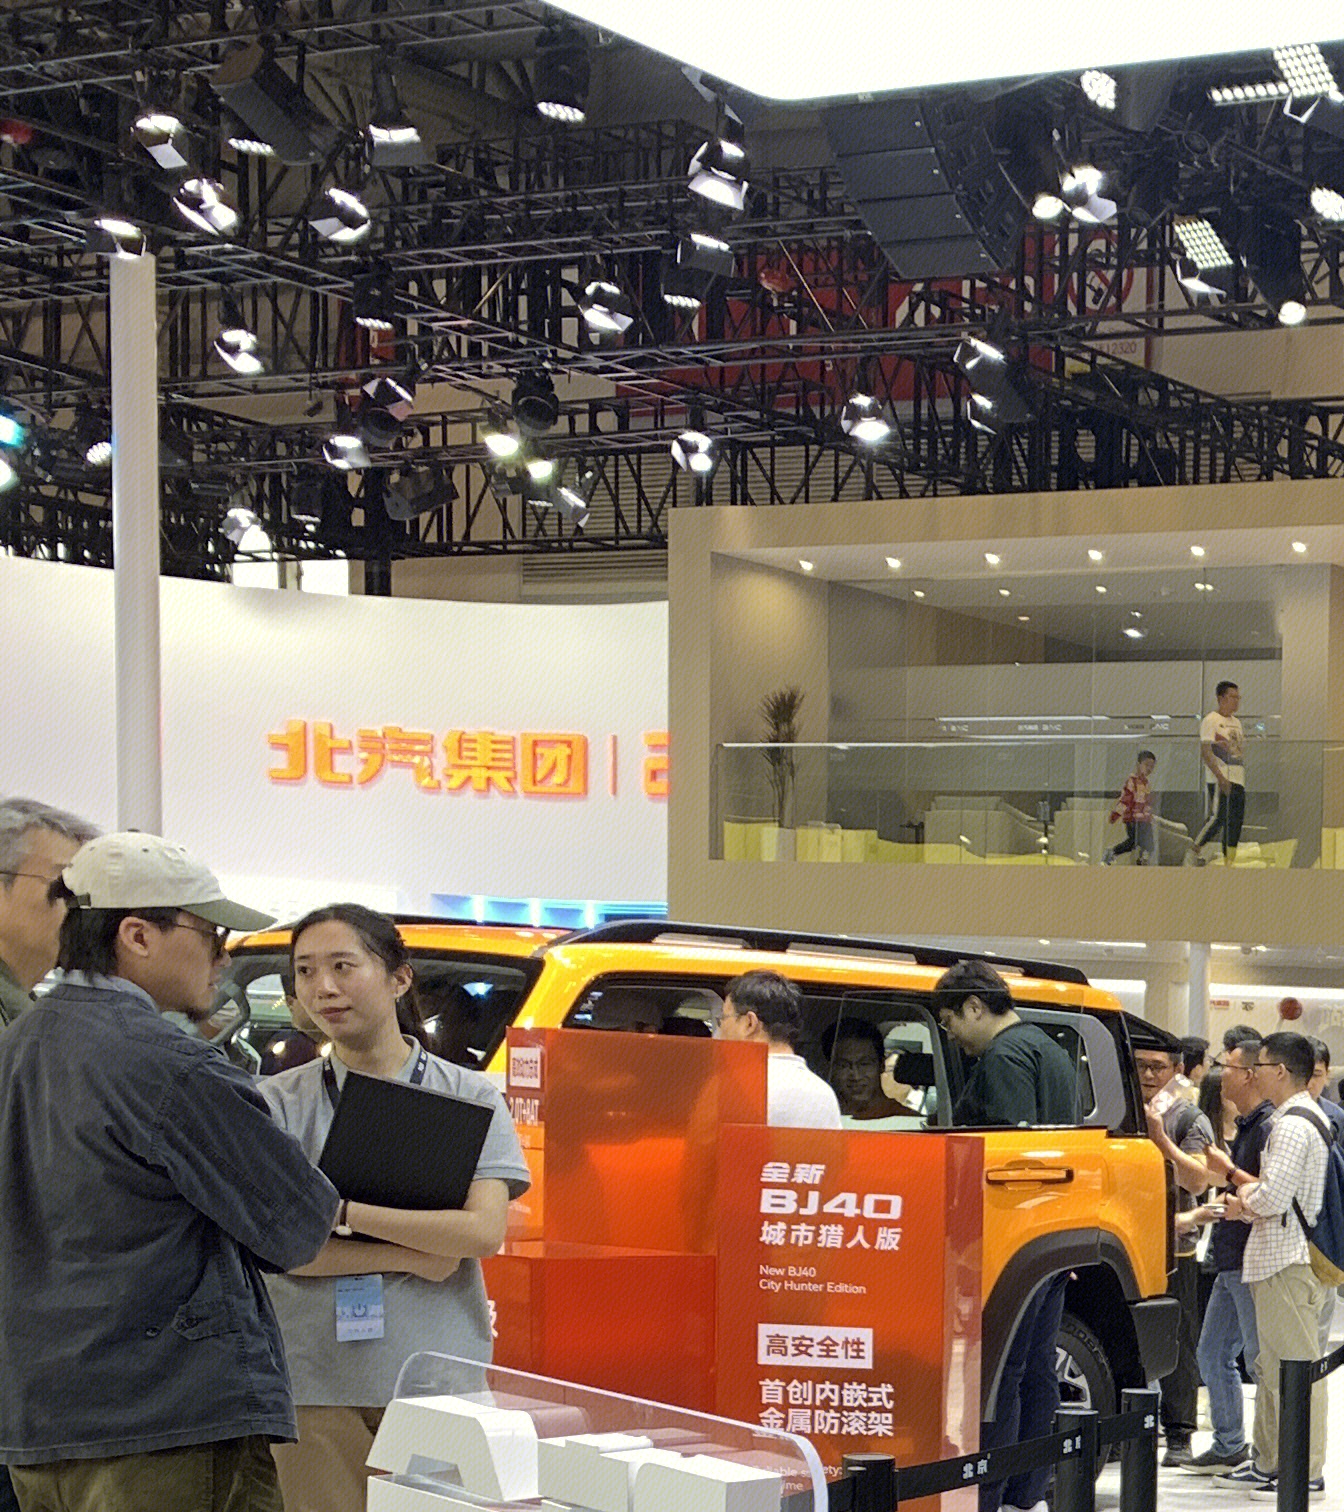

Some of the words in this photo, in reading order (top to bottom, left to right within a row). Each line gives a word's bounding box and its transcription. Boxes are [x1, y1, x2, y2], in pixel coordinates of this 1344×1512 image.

[267, 719, 591, 798] 北汽集团
[760, 1161, 826, 1185] 全新
[760, 1188, 903, 1220] BJ40
[759, 1220, 903, 1251] 城市猎人版
[759, 1264, 785, 1277] New
[788, 1266, 817, 1278] BJ40
[759, 1279, 782, 1293] City
[784, 1280, 824, 1292] Hunter
[826, 1282, 867, 1294] Edition
[766, 1333, 866, 1360] 高安全性
[758, 1379, 894, 1409] 首创内嵌式
[758, 1407, 894, 1437] 金属防滚架
